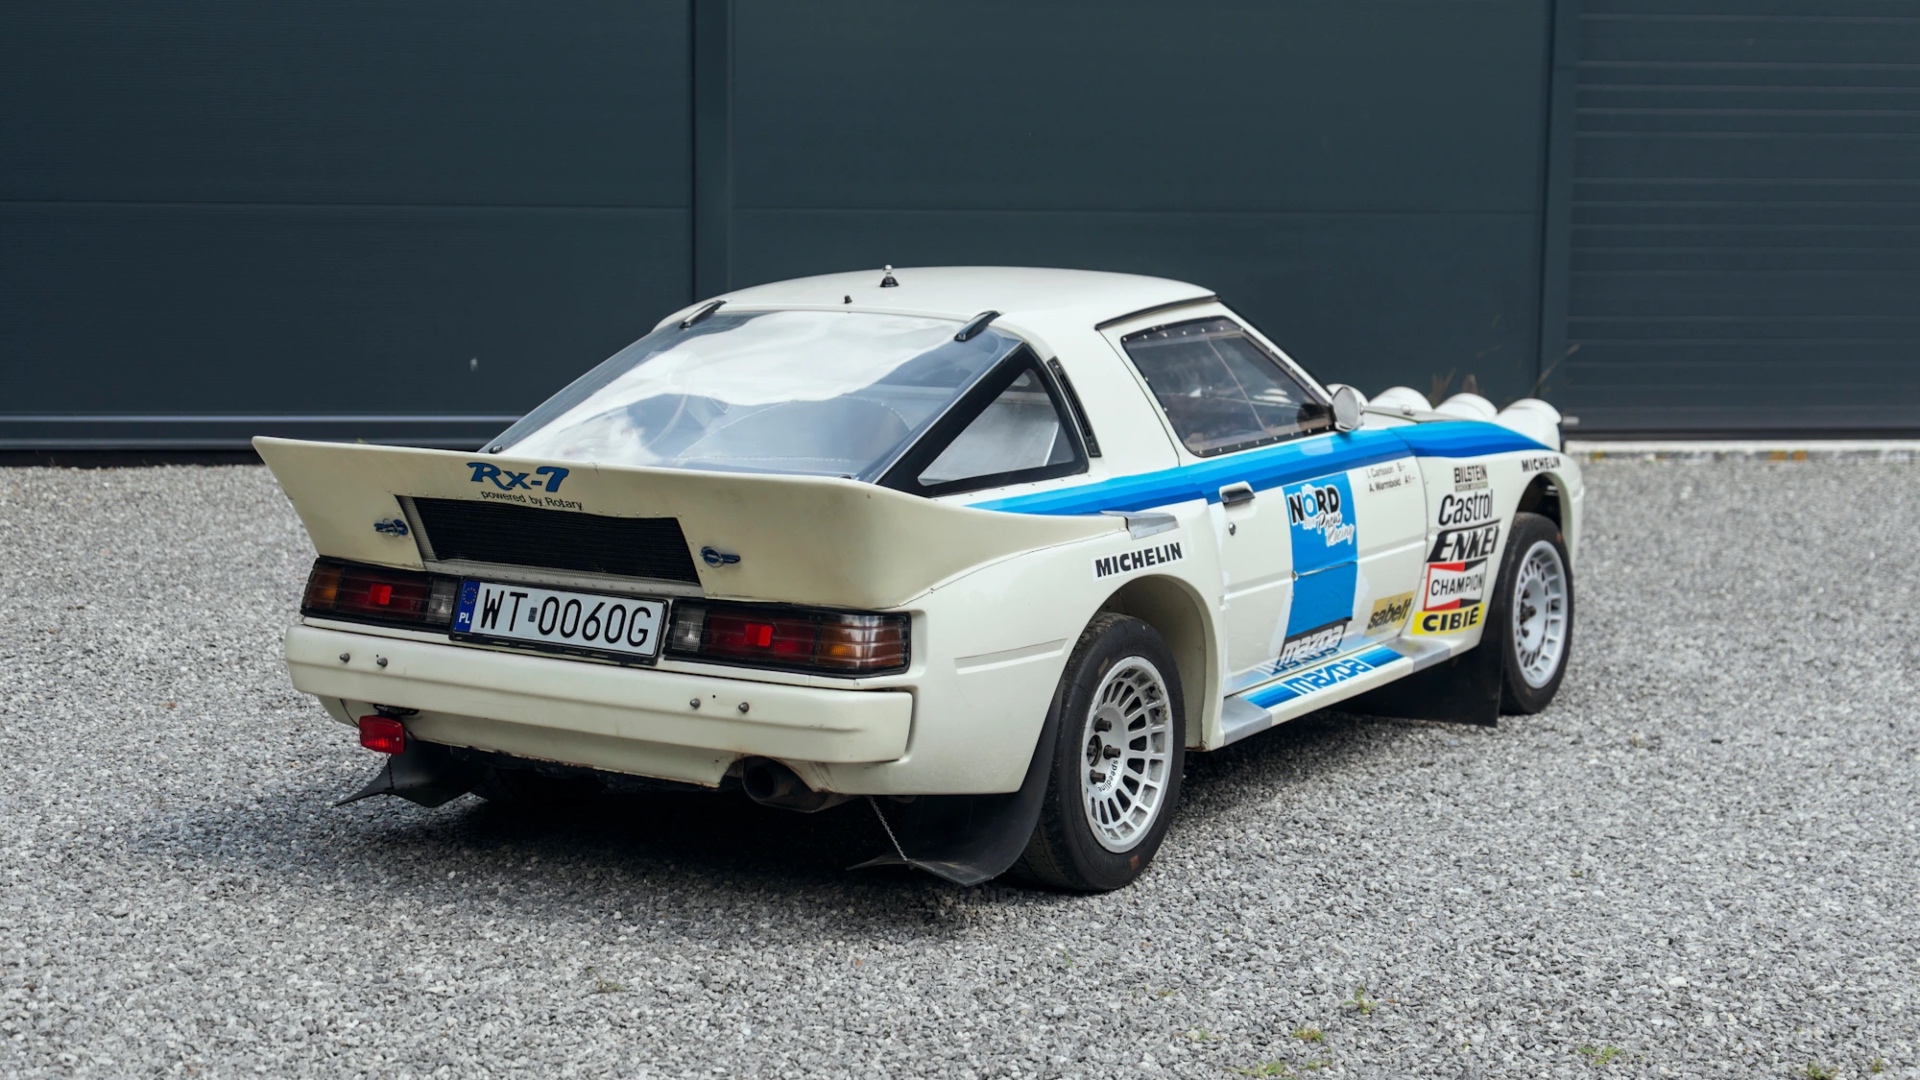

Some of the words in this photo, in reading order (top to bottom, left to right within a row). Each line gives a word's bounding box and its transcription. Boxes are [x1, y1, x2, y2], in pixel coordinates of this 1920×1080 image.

[1454, 464, 1488, 483] BILSTEIN
[1521, 456, 1561, 472] MICHELIN
[480, 490, 526, 503] powered
[528, 495, 543, 506] by
[544, 496, 583, 511] Rotary
[1288, 486, 1340, 524] NORD
[1438, 488, 1493, 526] Castrol
[1426, 520, 1500, 563] ENKEI
[1095, 542, 1183, 578] MICHELIN
[1430, 573, 1484, 596] CHAMPION
[458, 611, 471, 624] PL
[1367, 598, 1413, 630] sabelt
[1278, 625, 1344, 665] mazda
[1281, 658, 1373, 695] mazda
